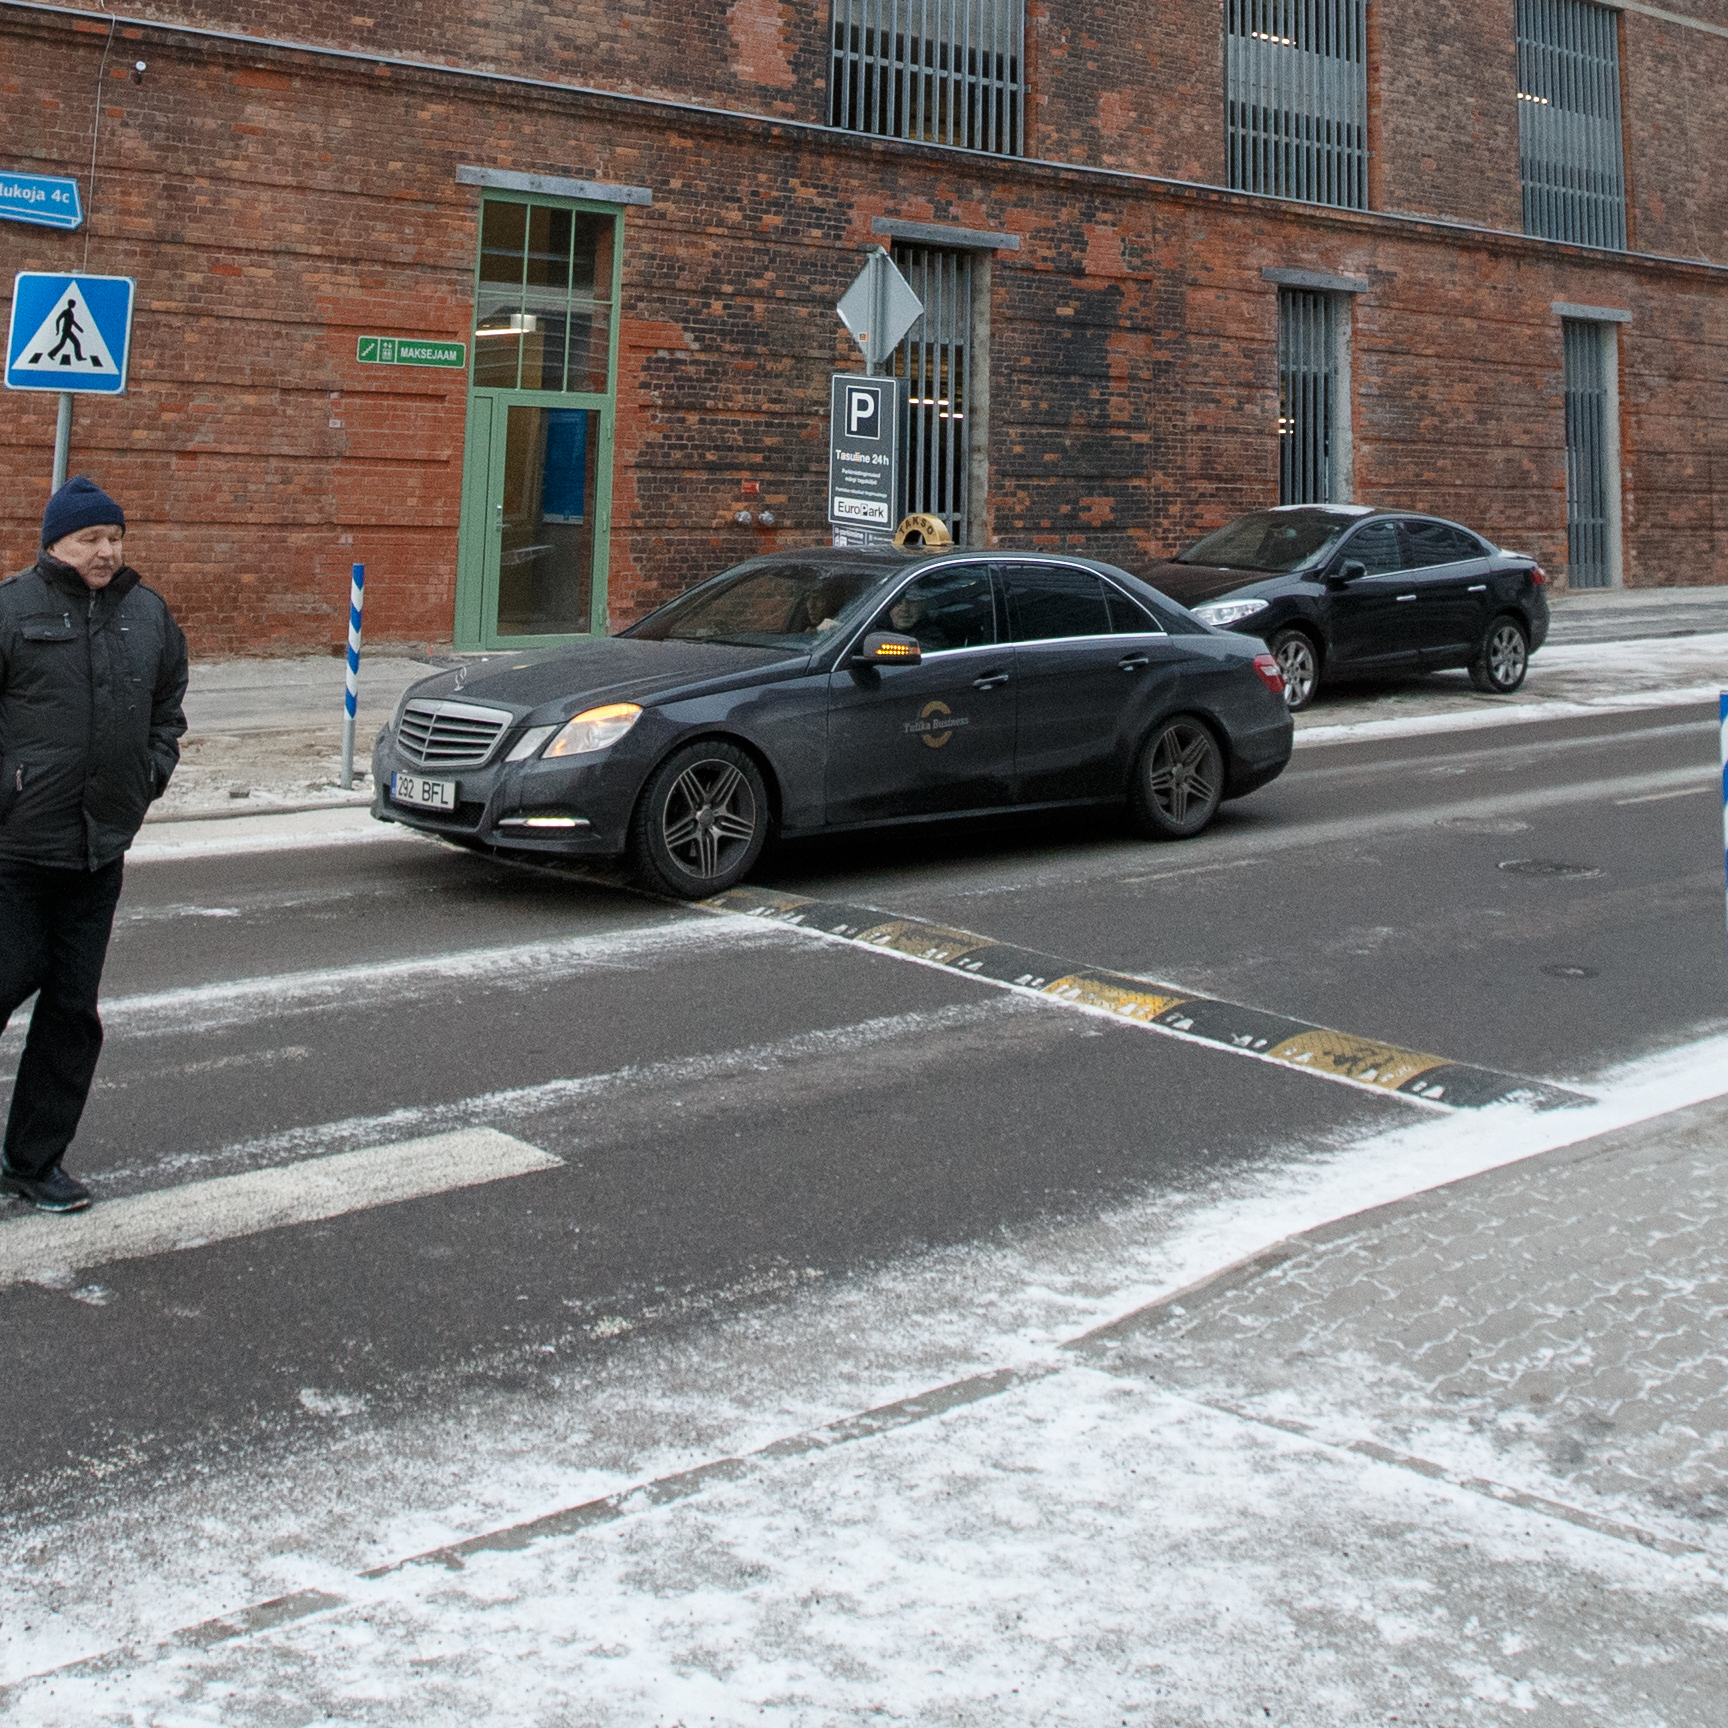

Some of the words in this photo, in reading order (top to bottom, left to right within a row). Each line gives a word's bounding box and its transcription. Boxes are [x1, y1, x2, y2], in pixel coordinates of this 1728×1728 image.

[51, 189, 70, 204] 4c
[400, 346, 457, 361] MAKSEJAAM
[851, 391, 875, 433] P
[835, 449, 871, 464] Tasuline
[837, 500, 885, 519] EuroPark
[898, 516, 935, 536] TAKSO
[932, 716, 969, 730] Business
[398, 776, 414, 799] 292
[421, 780, 449, 805] BFL
